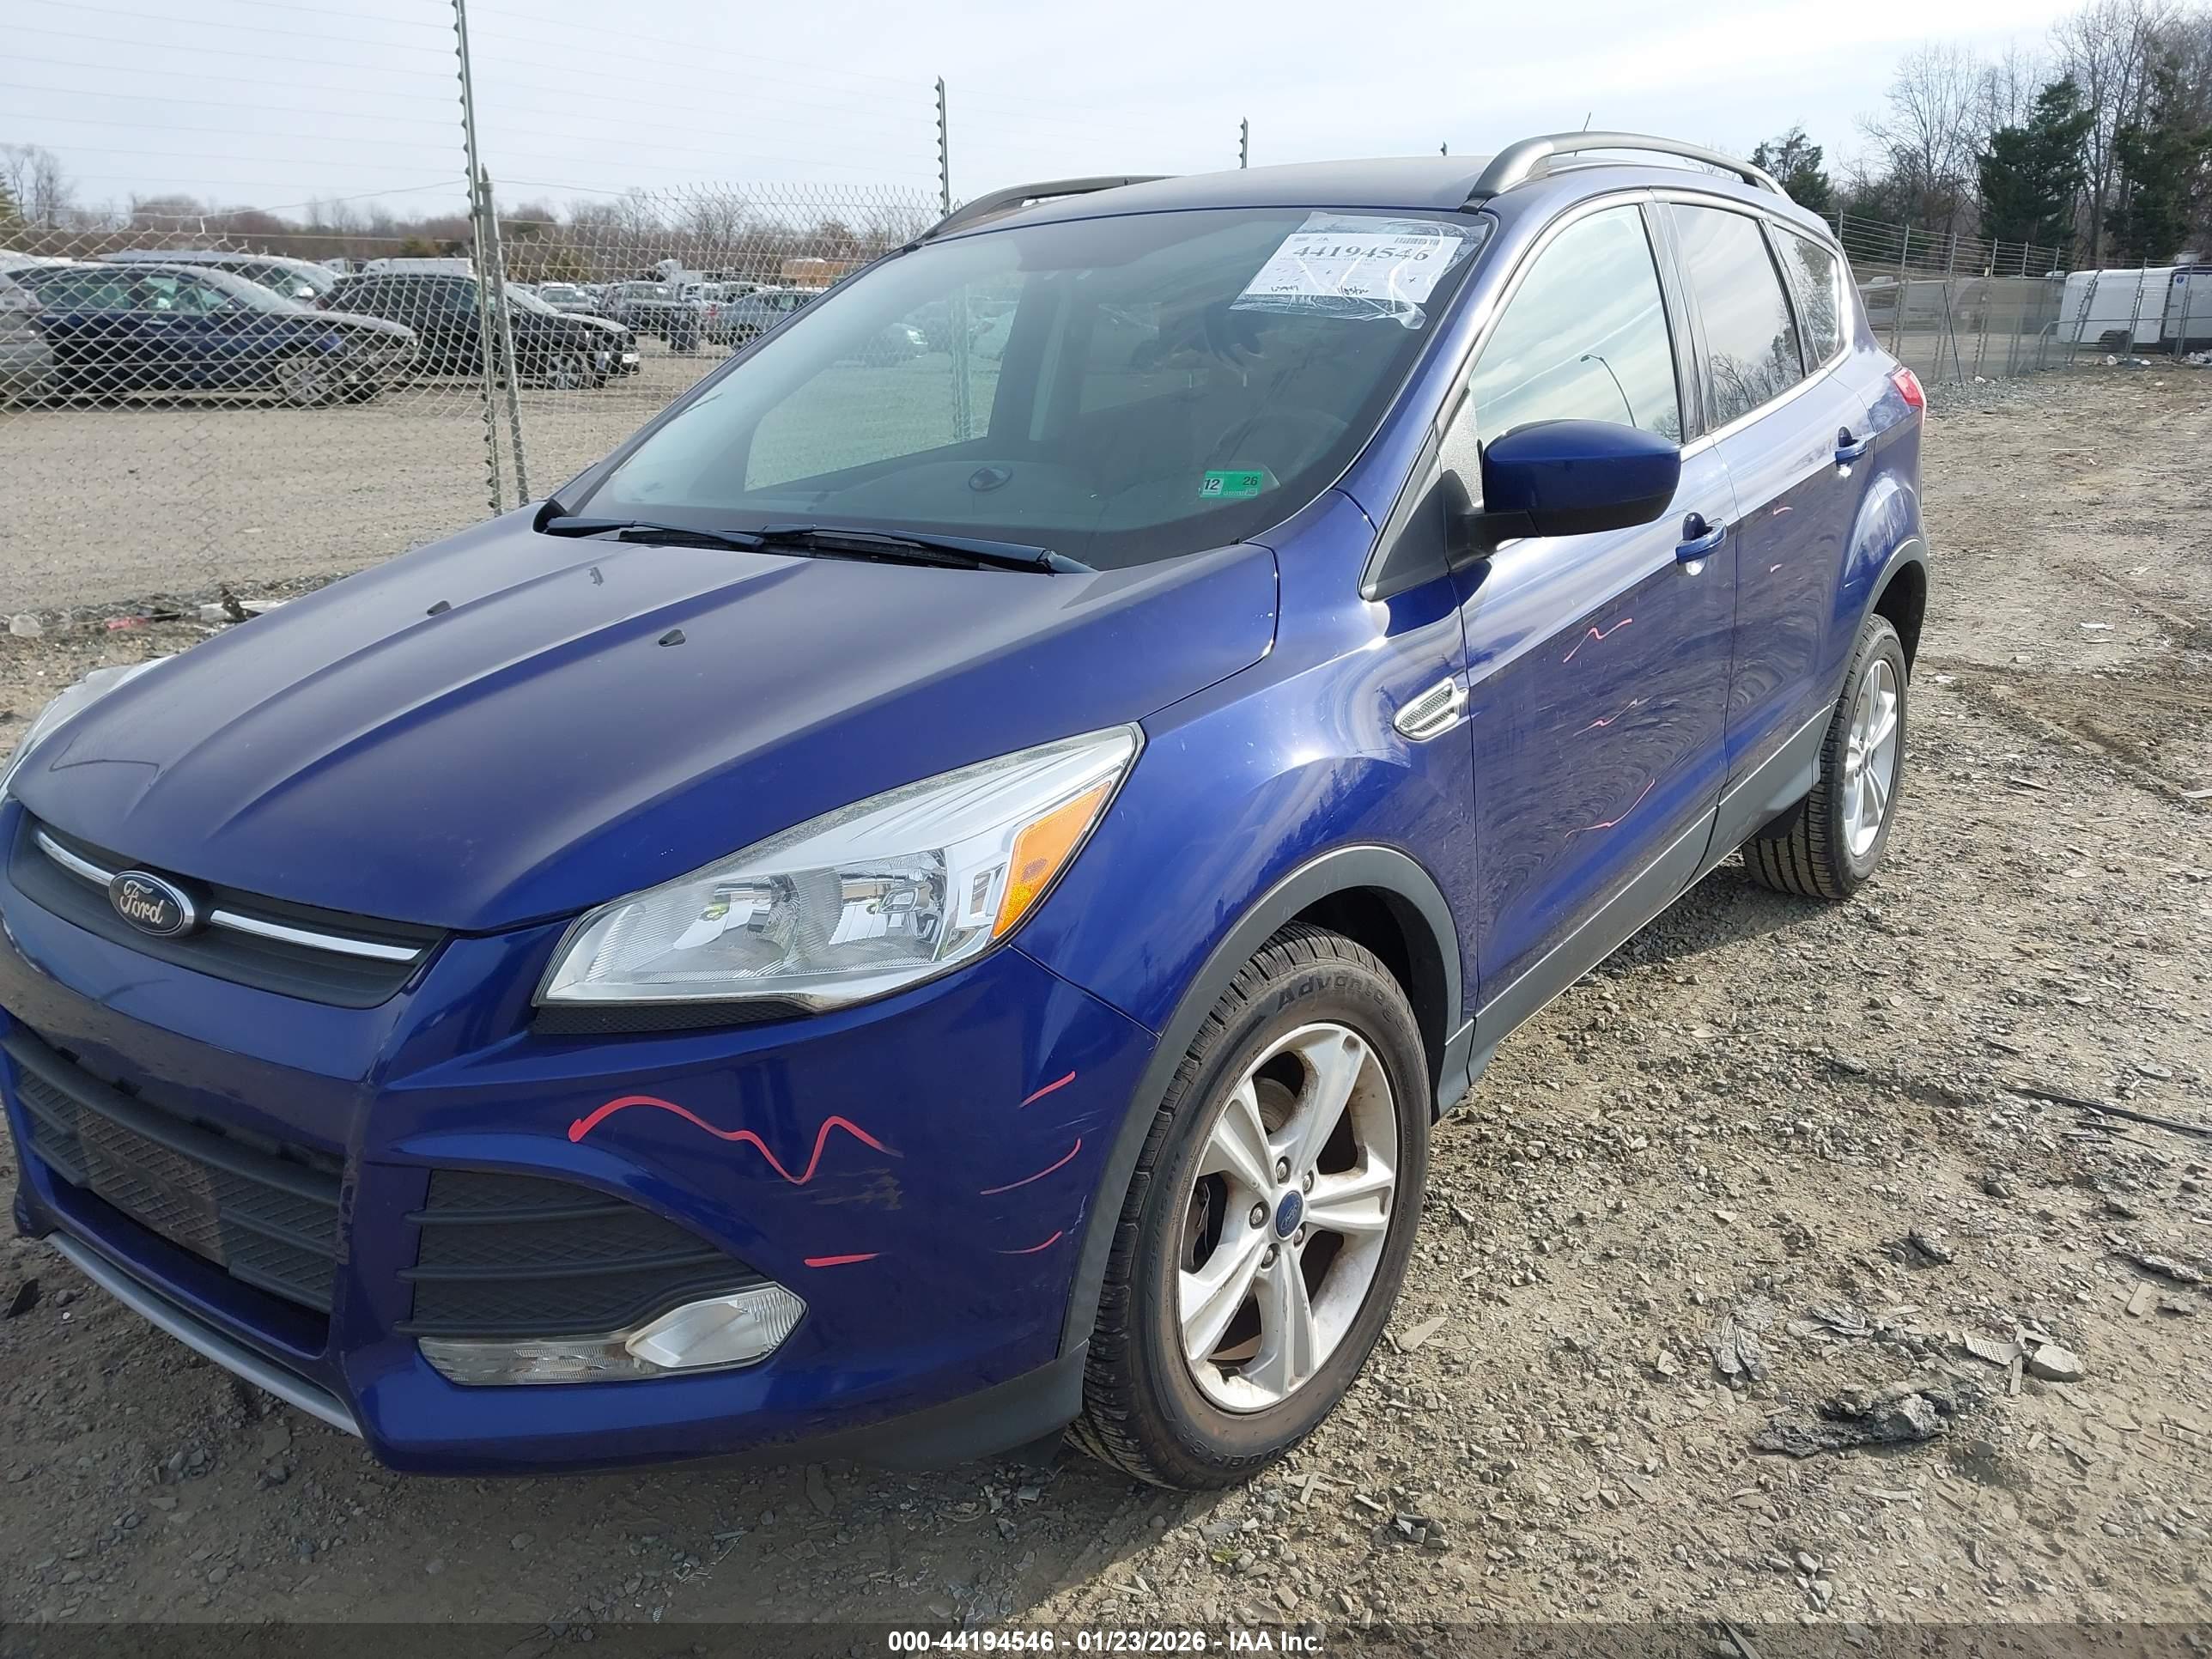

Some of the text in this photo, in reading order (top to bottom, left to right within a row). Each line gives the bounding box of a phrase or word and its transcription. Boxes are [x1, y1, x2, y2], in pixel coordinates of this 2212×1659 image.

[1293, 246, 1429, 261] 44194546
[1204, 476, 1258, 490] 12 26
[120, 880, 165, 924] Ford
